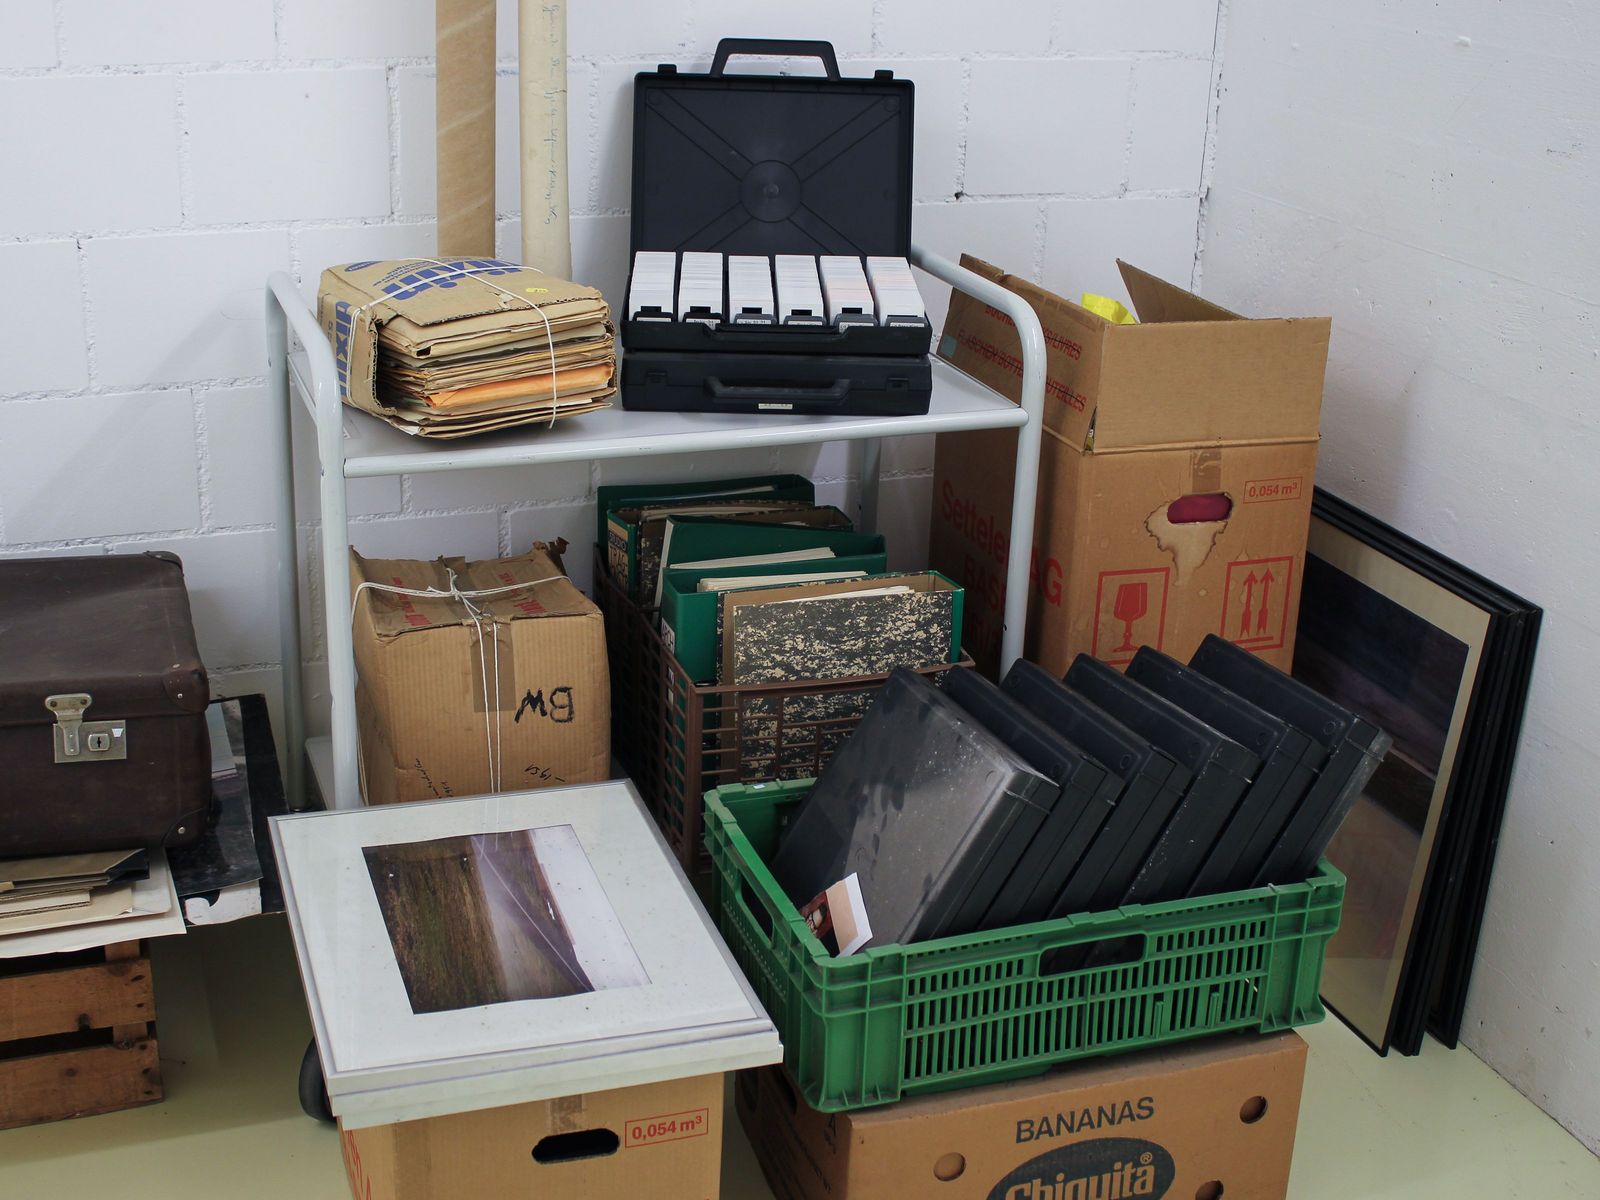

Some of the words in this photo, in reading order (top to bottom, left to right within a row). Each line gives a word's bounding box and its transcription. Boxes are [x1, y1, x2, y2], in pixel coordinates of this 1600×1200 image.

[1249, 484, 1280, 498] 0,054
[632, 1120, 677, 1141] 0,054
[1016, 1096, 1154, 1144] BANANAS
